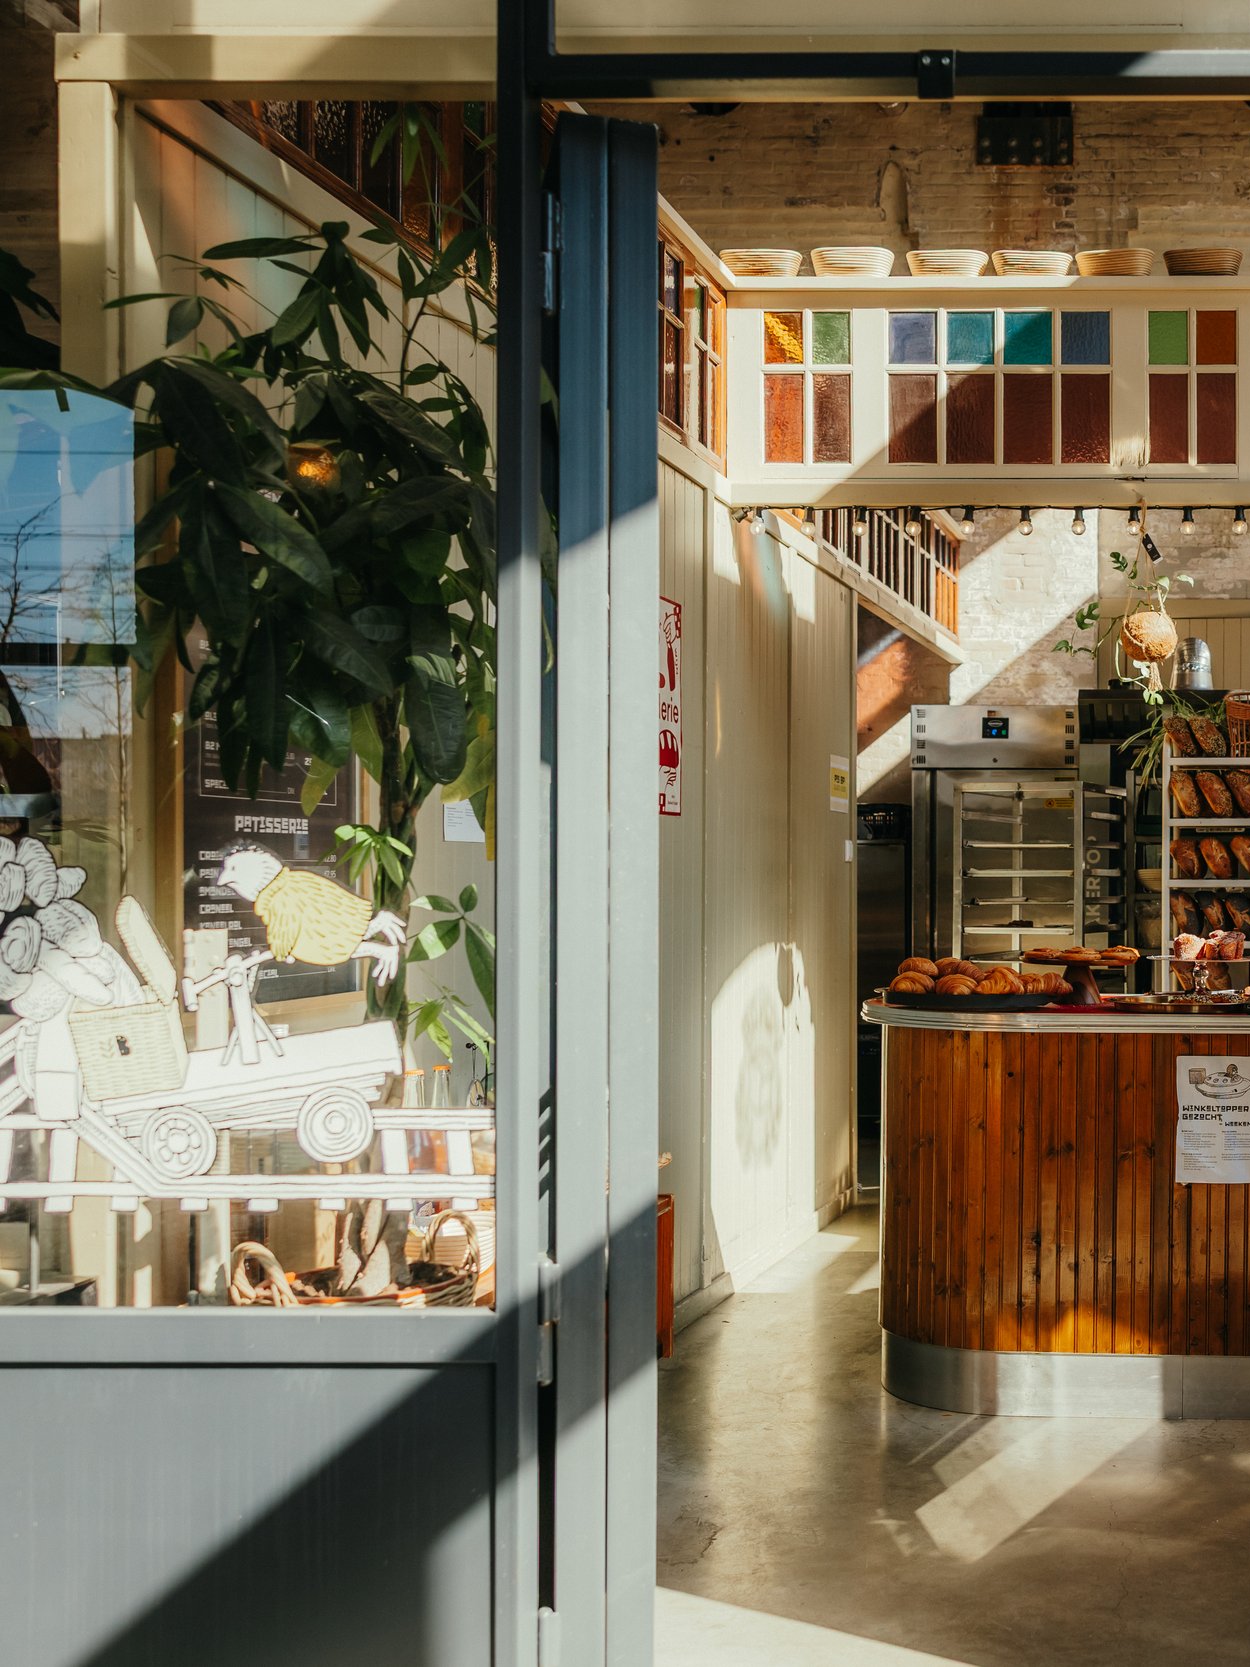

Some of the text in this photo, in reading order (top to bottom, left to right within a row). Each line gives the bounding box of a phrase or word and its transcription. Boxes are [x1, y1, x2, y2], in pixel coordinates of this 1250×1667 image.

[658, 693, 679, 723] lerie
[204, 778, 229, 790] SPECI
[235, 815, 309, 835] PATISSERIE
[1182, 1113, 1223, 1121] GEZOCHT
